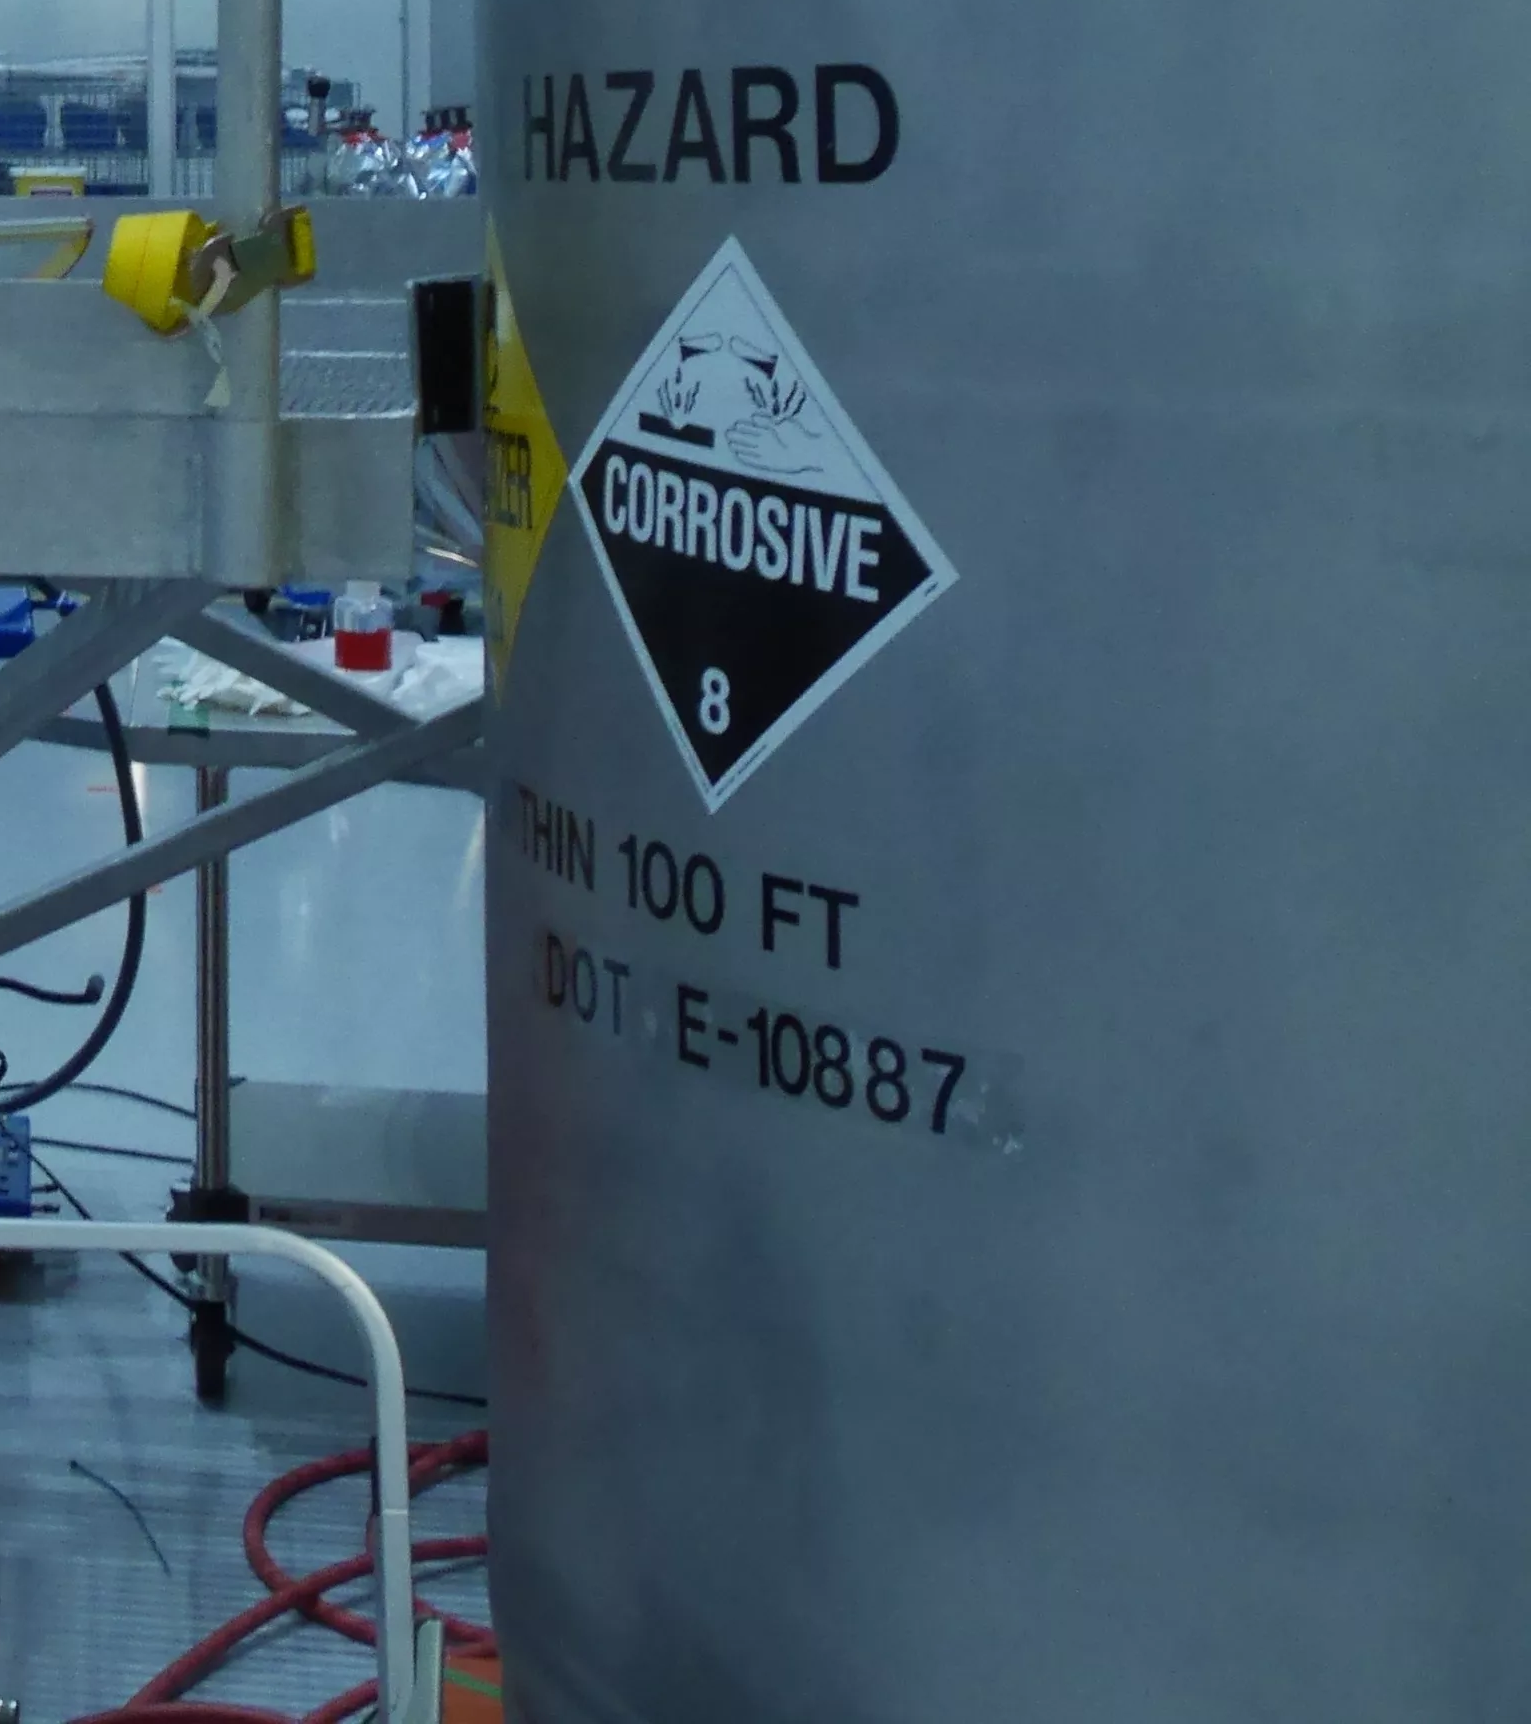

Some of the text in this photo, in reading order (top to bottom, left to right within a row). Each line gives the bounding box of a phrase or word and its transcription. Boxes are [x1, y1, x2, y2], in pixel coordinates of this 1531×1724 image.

[522, 62, 901, 185] HAZARD
[603, 453, 884, 604] CORROSIVE
[699, 666, 732, 737] 8
[618, 835, 726, 936] 100
[759, 870, 861, 972] FT
[543, 931, 968, 1136] DOT E-10887
